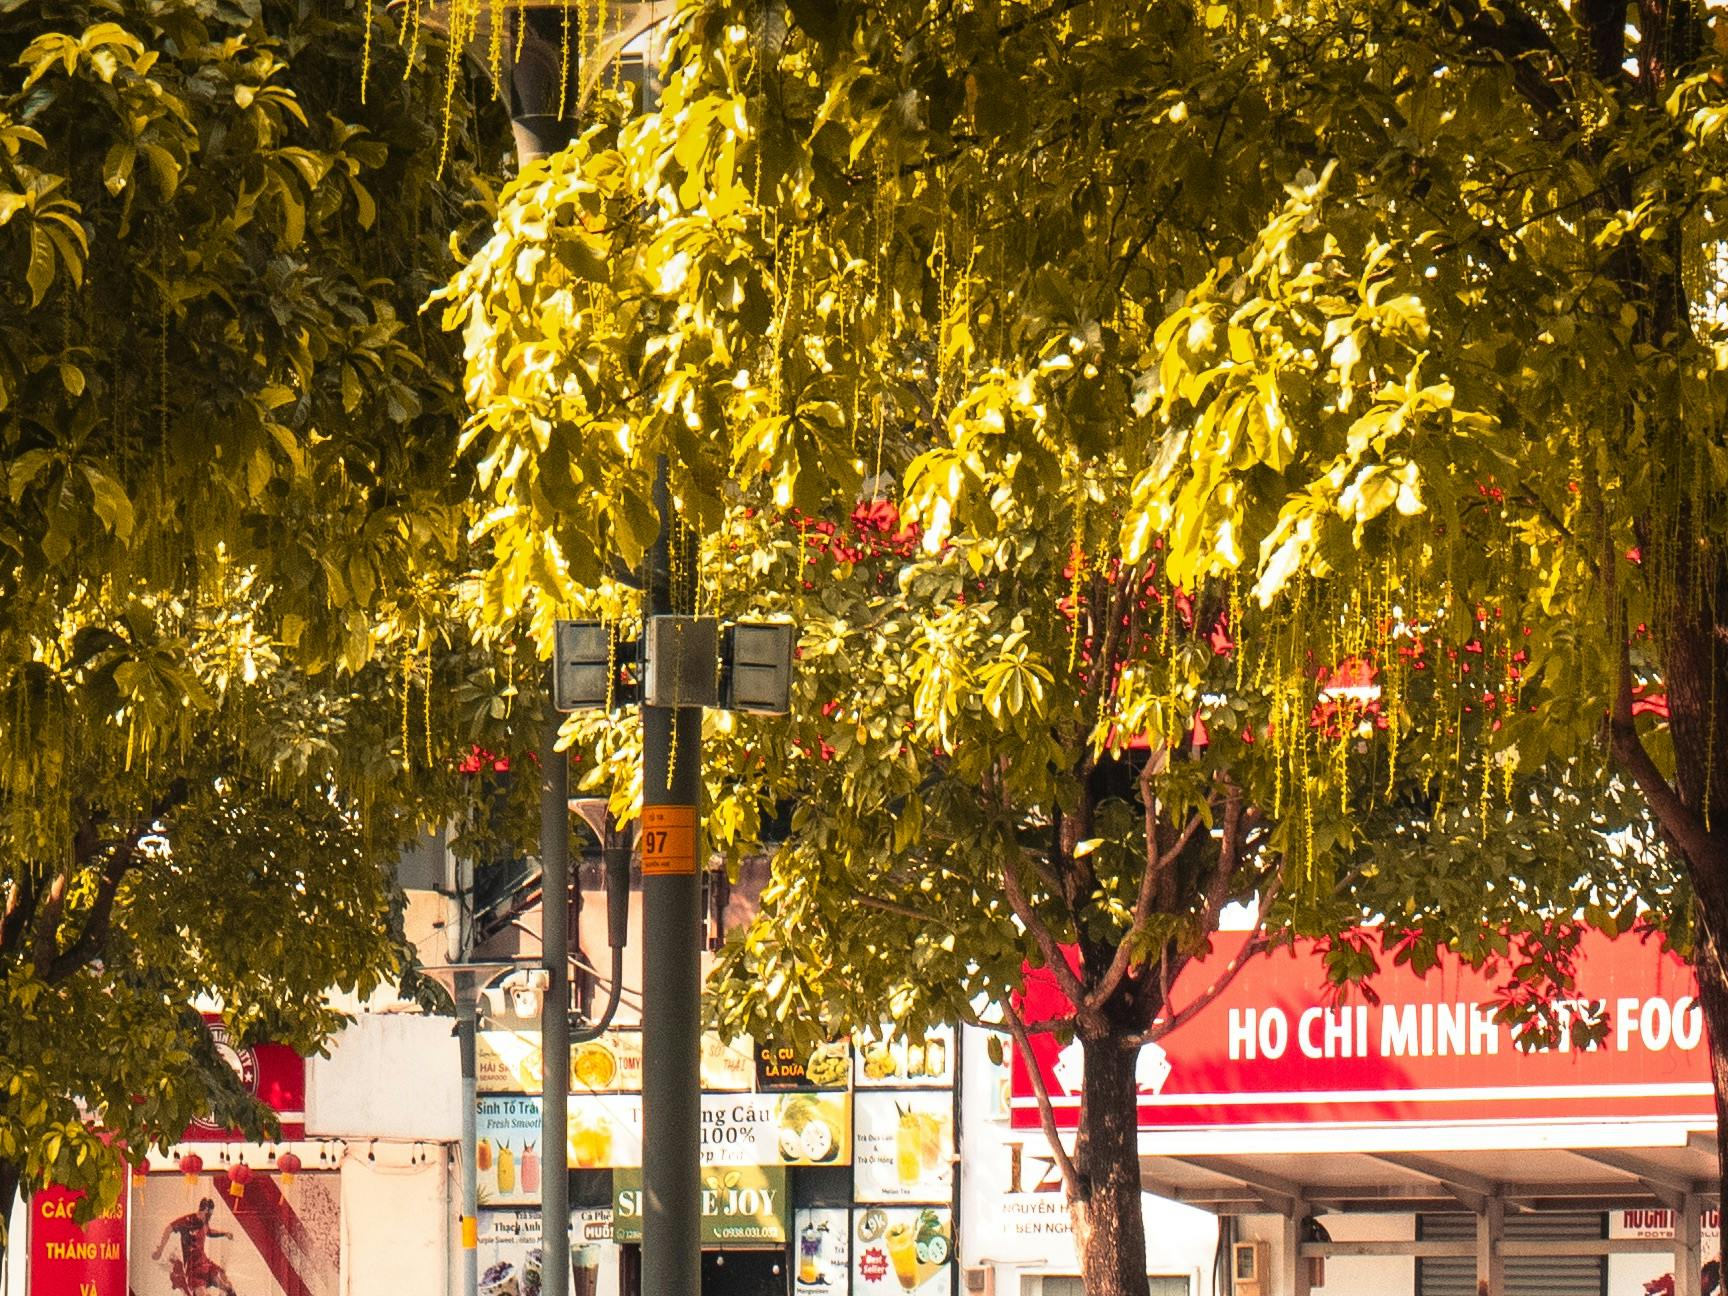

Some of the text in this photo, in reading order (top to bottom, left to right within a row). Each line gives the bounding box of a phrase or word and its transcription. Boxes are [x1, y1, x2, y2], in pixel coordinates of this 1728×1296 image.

[646, 831, 668, 854] 97
[1228, 1008, 1288, 1060] HO
[1298, 1004, 1368, 1059] CHI
[1380, 1001, 1499, 1057] MINH
[476, 1101, 500, 1114] Sinh
[504, 1098, 516, 1115] Tố
[732, 1103, 770, 1123] Cầu
[487, 1119, 509, 1129] Fresh
[701, 1128, 755, 1143] 100%
[724, 1188, 776, 1217] JOY
[46, 1236, 120, 1261] THÁNG TÁM
